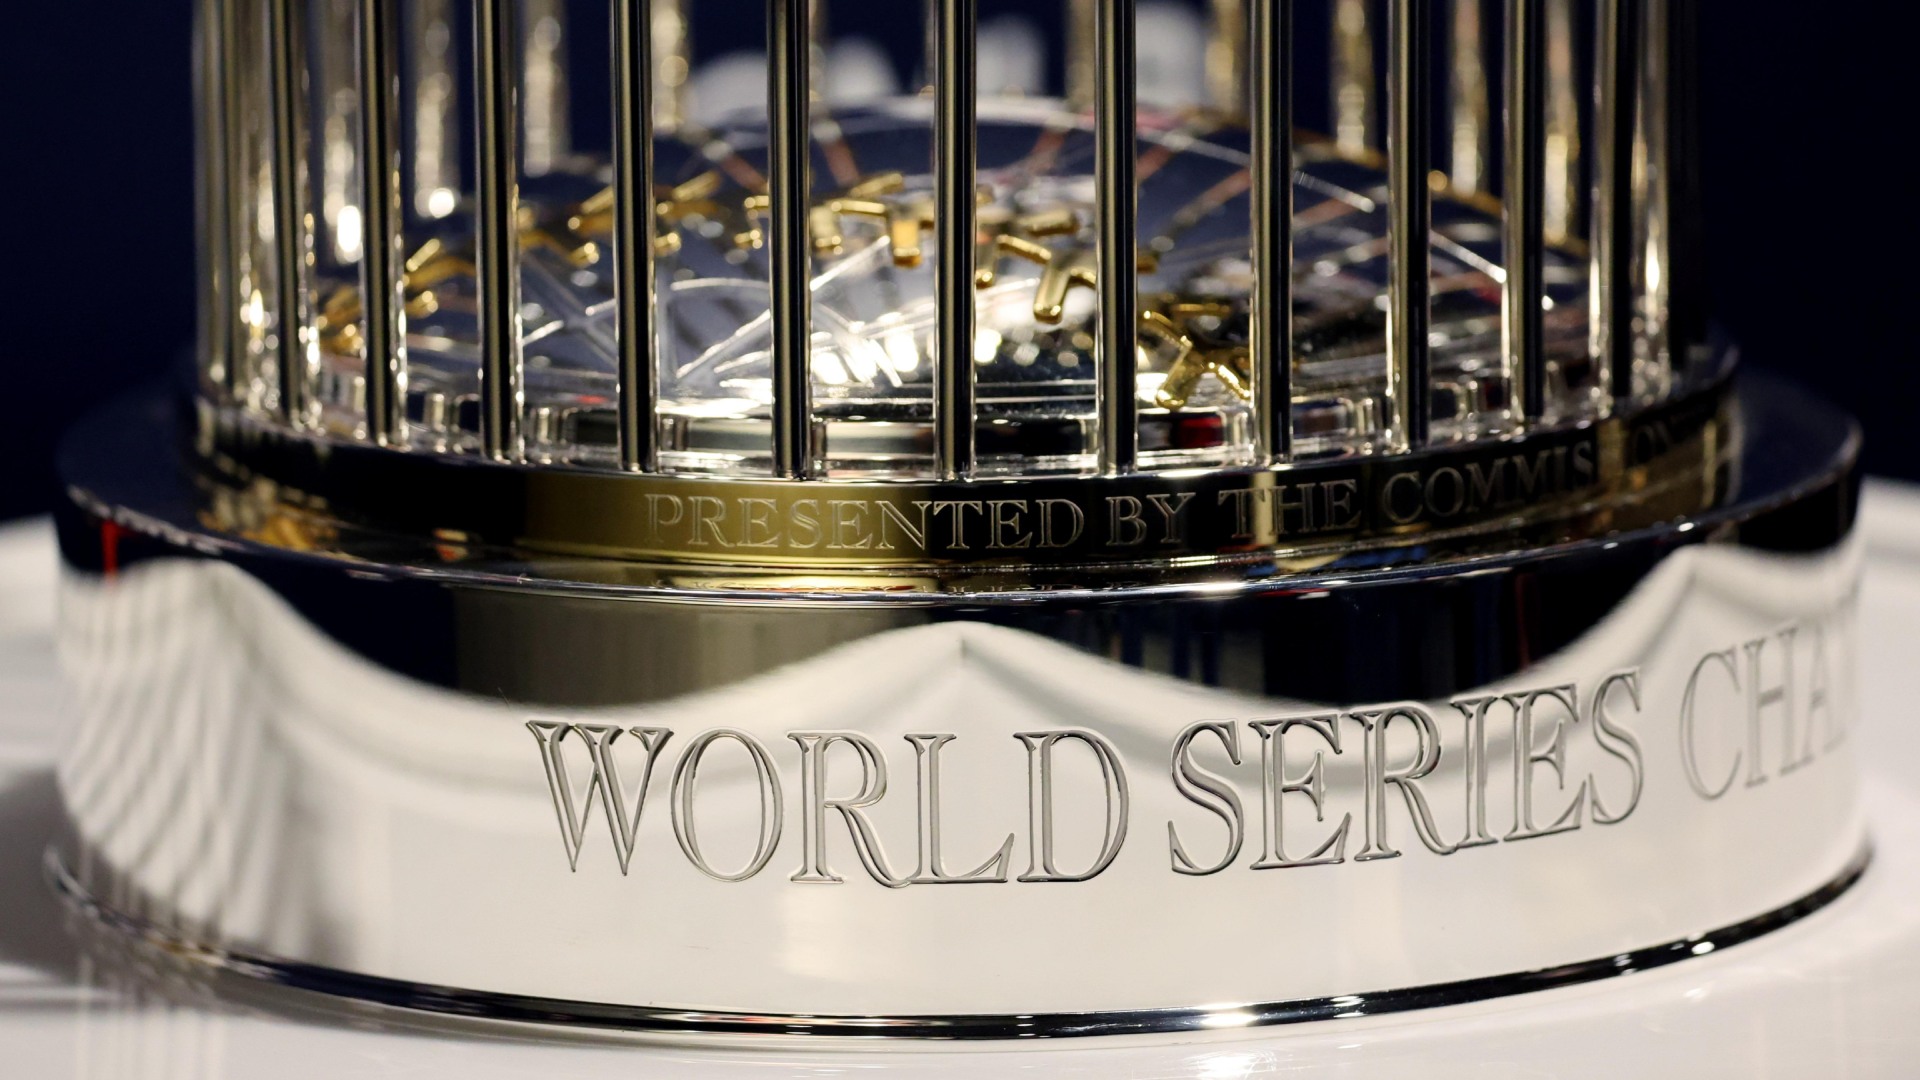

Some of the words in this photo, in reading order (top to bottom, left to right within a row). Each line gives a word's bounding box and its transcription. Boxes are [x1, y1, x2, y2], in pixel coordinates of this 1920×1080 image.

[643, 492, 1085, 551] PRESENTED
[1105, 491, 1196, 547] BY
[1217, 477, 1362, 540] THE
[525, 718, 1131, 889] WORLD
[1167, 665, 1644, 878] SERIES
[1678, 618, 1853, 801] CHA
